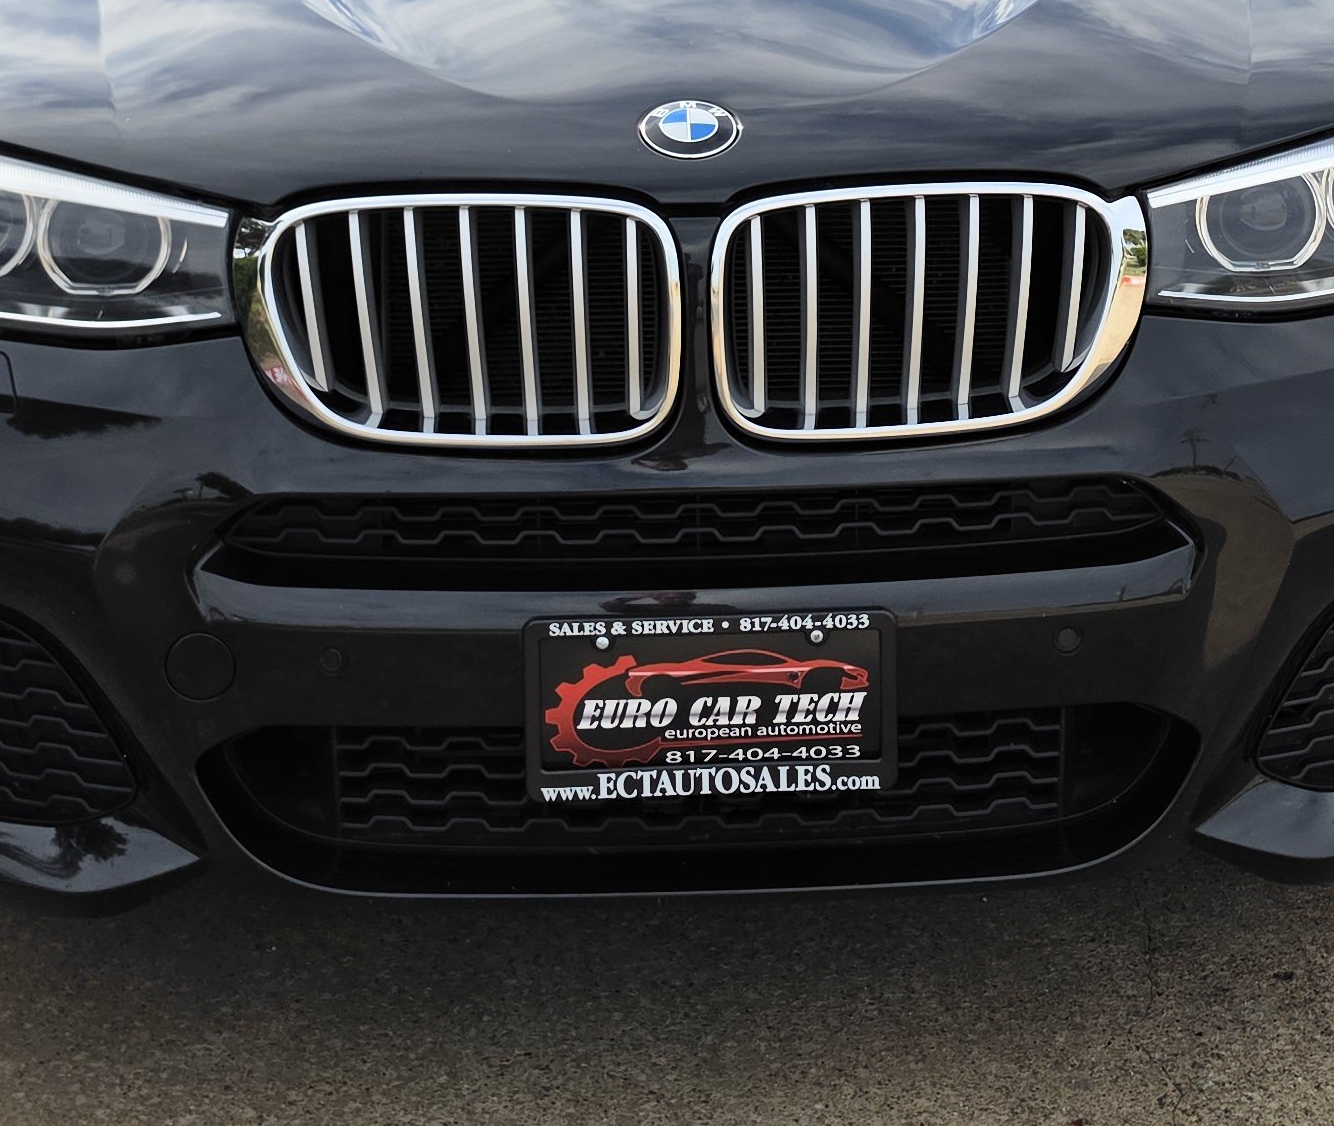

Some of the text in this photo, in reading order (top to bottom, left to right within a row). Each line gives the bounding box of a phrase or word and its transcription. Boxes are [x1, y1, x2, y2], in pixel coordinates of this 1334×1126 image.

[651, 101, 728, 117] BMW
[548, 613, 870, 637] SALES & SERVICE 817-404-4033
[576, 691, 868, 730] EURO CAR TECH
[664, 721, 863, 741] european automotive
[665, 745, 862, 764] 817-404-4033
[540, 764, 882, 803] www.ECTAUTOSALES.com
